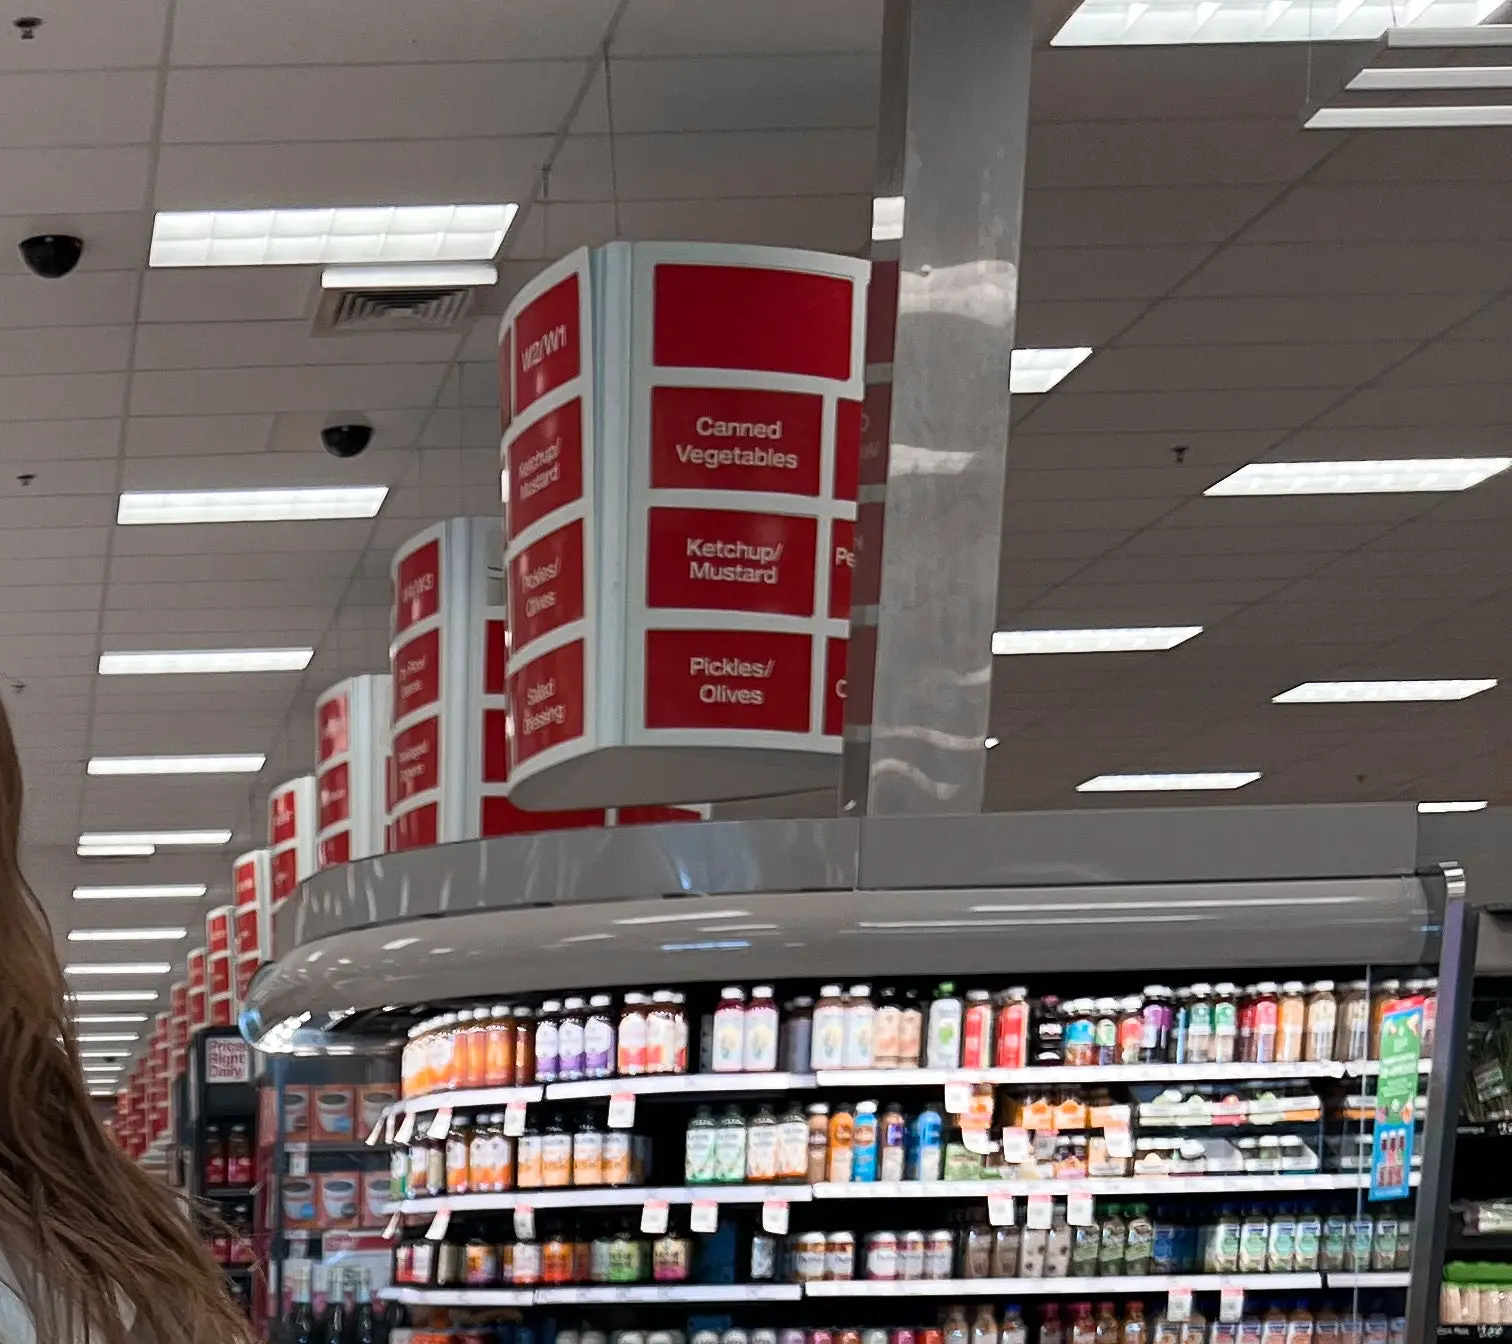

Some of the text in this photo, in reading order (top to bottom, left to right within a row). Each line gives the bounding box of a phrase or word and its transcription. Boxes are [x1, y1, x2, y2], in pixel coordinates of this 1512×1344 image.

[696, 416, 782, 440] Canned
[675, 445, 799, 469] Vegetables
[687, 538, 783, 563] Ketchup/
[690, 561, 779, 585] Mustard
[690, 657, 774, 680] Pickles/
[699, 684, 764, 706] Olives
